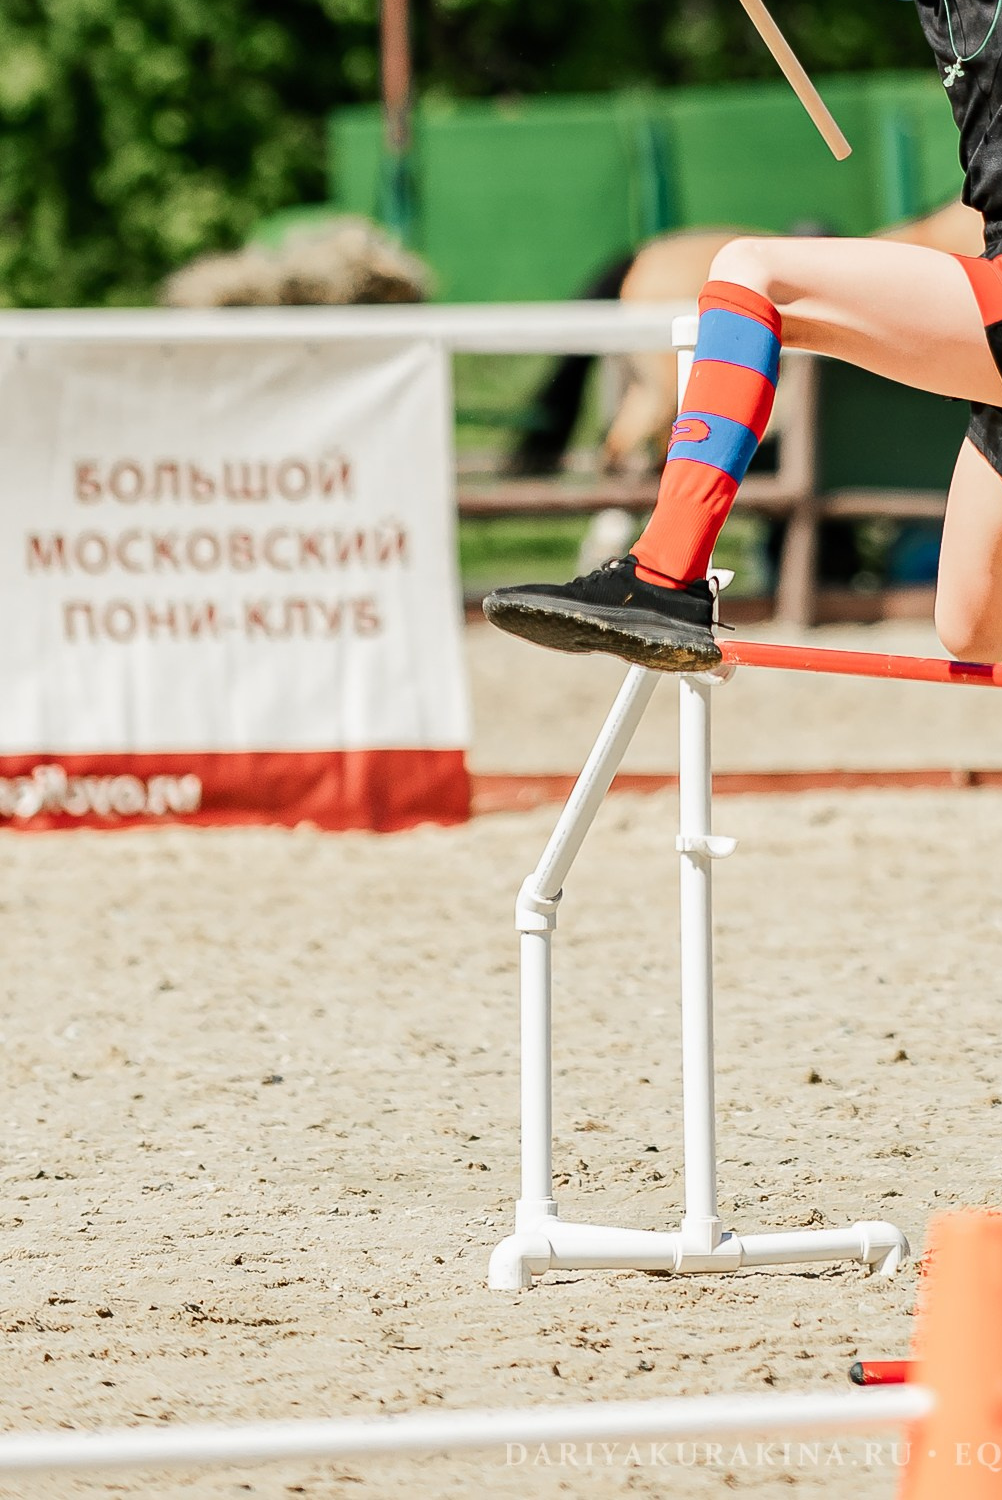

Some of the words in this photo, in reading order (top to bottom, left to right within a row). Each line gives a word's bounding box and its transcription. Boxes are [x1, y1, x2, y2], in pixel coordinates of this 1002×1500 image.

[73, 448, 353, 502] БОЛЬШОЙ
[25, 515, 408, 575] МОСКОВСКИЙ
[63, 595, 383, 643] ПОНИ-КЛУБ
